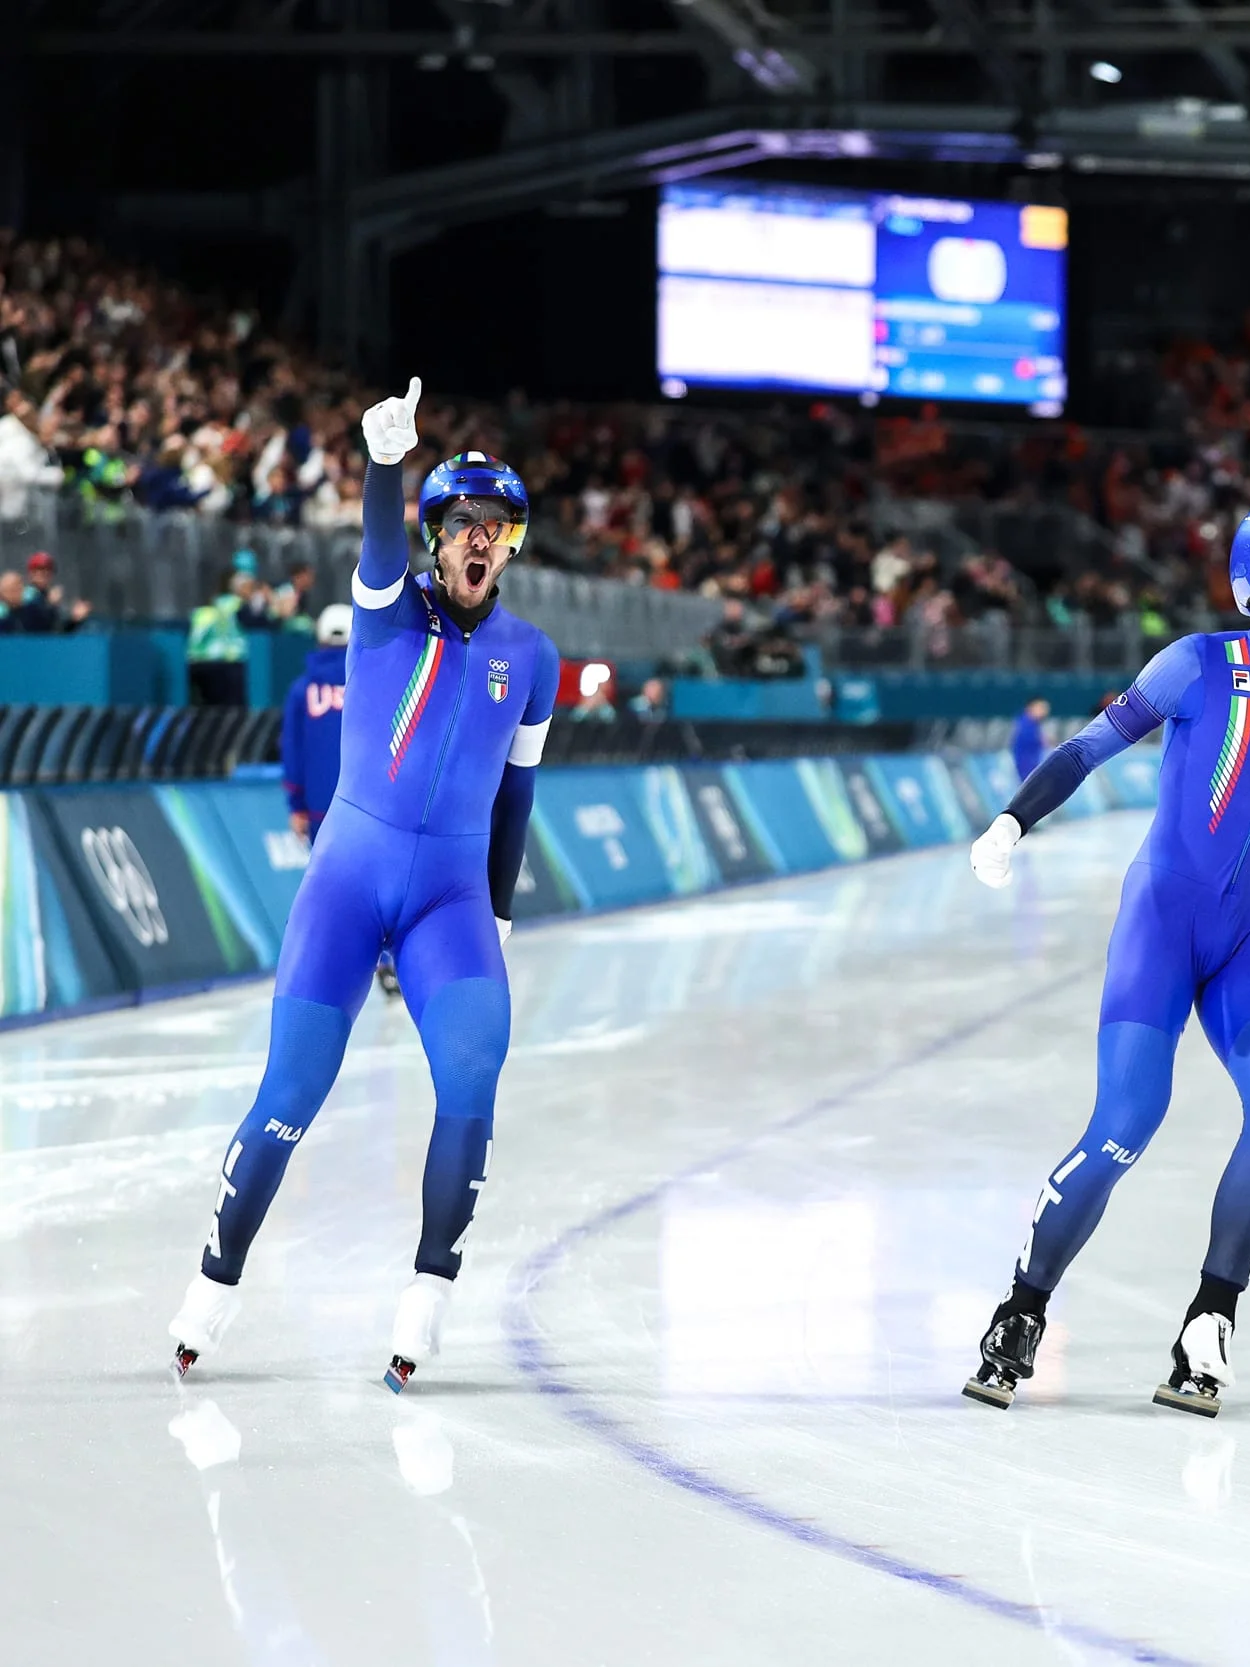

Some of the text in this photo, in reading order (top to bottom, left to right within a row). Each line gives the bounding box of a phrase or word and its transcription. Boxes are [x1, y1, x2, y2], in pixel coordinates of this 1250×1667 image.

[264, 1117, 303, 1142] FILA
[1101, 1138, 1139, 1165] FILA
[207, 1139, 244, 1259] ITA
